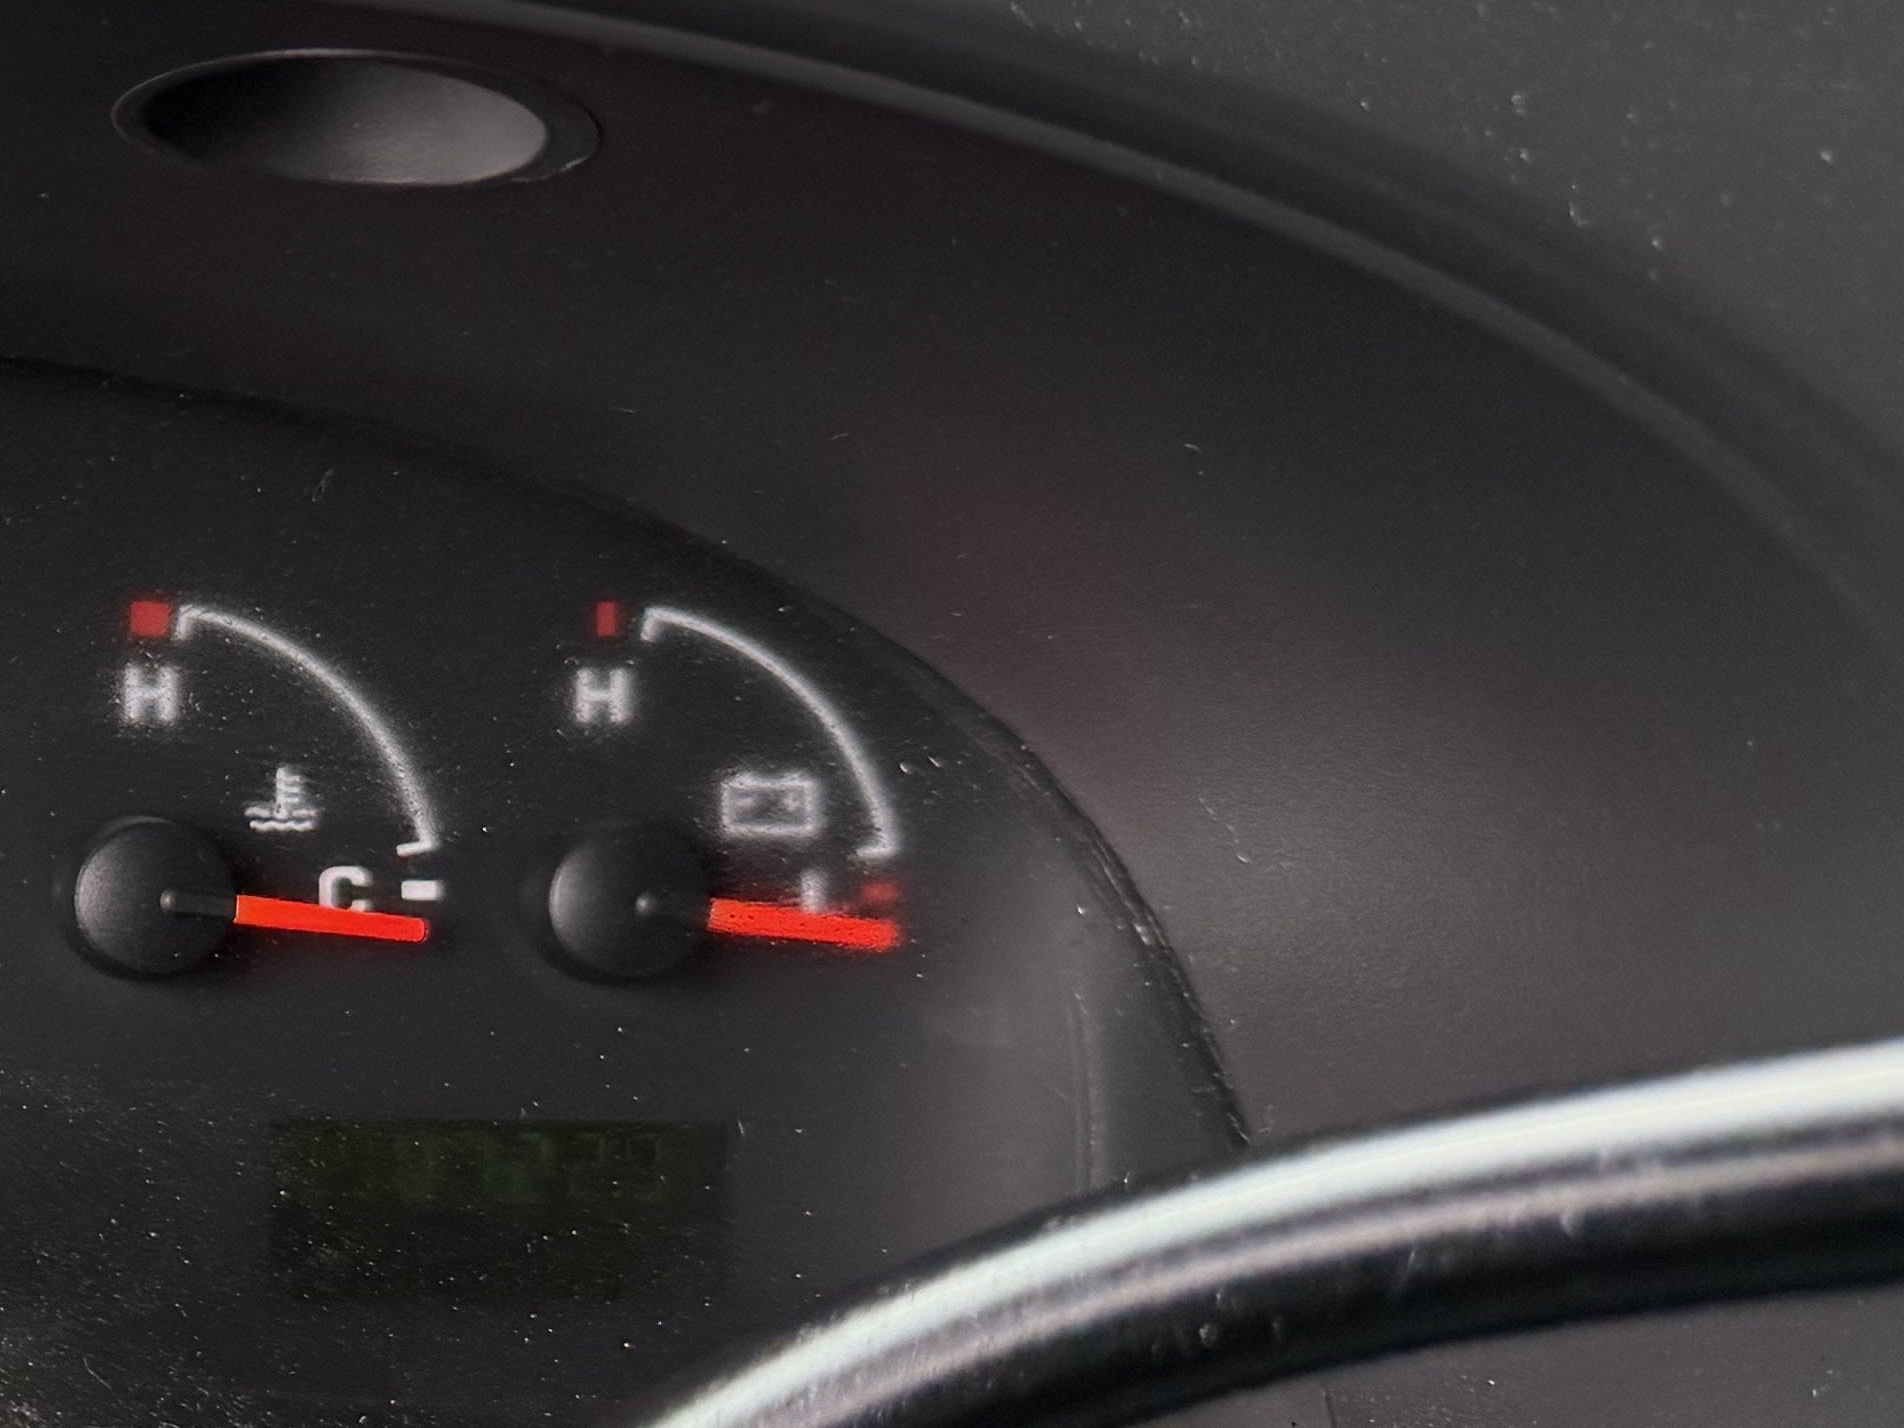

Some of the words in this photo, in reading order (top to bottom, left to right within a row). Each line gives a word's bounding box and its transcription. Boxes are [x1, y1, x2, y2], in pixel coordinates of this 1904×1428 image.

[120, 666, 180, 724] H
[574, 668, 631, 724] H
[318, 865, 371, 911] C
